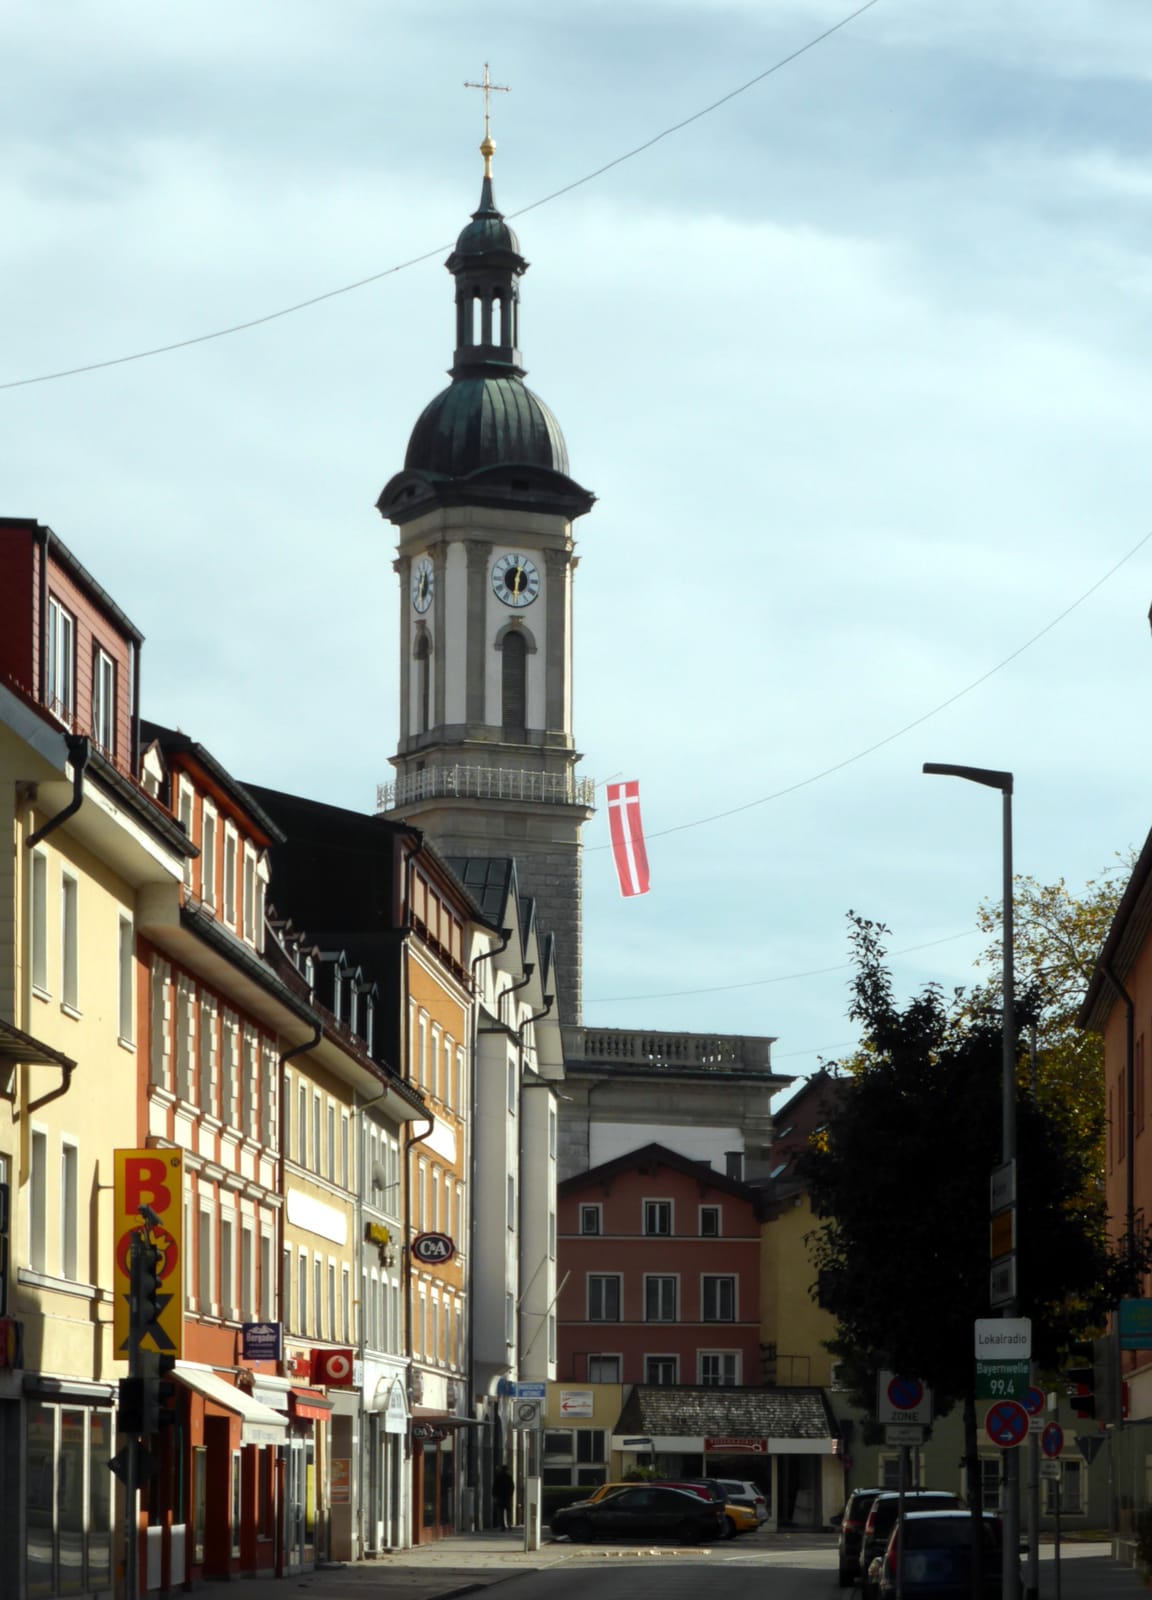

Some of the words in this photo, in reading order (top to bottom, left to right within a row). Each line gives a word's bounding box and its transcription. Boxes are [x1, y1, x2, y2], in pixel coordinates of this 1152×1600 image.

[117, 1157, 178, 1350] BOX
[419, 1240, 447, 1256] C&A
[978, 1332, 1028, 1345] Lokalradio
[976, 1361, 1029, 1376] Bayernwelle
[890, 1411, 919, 1421] ZONE
